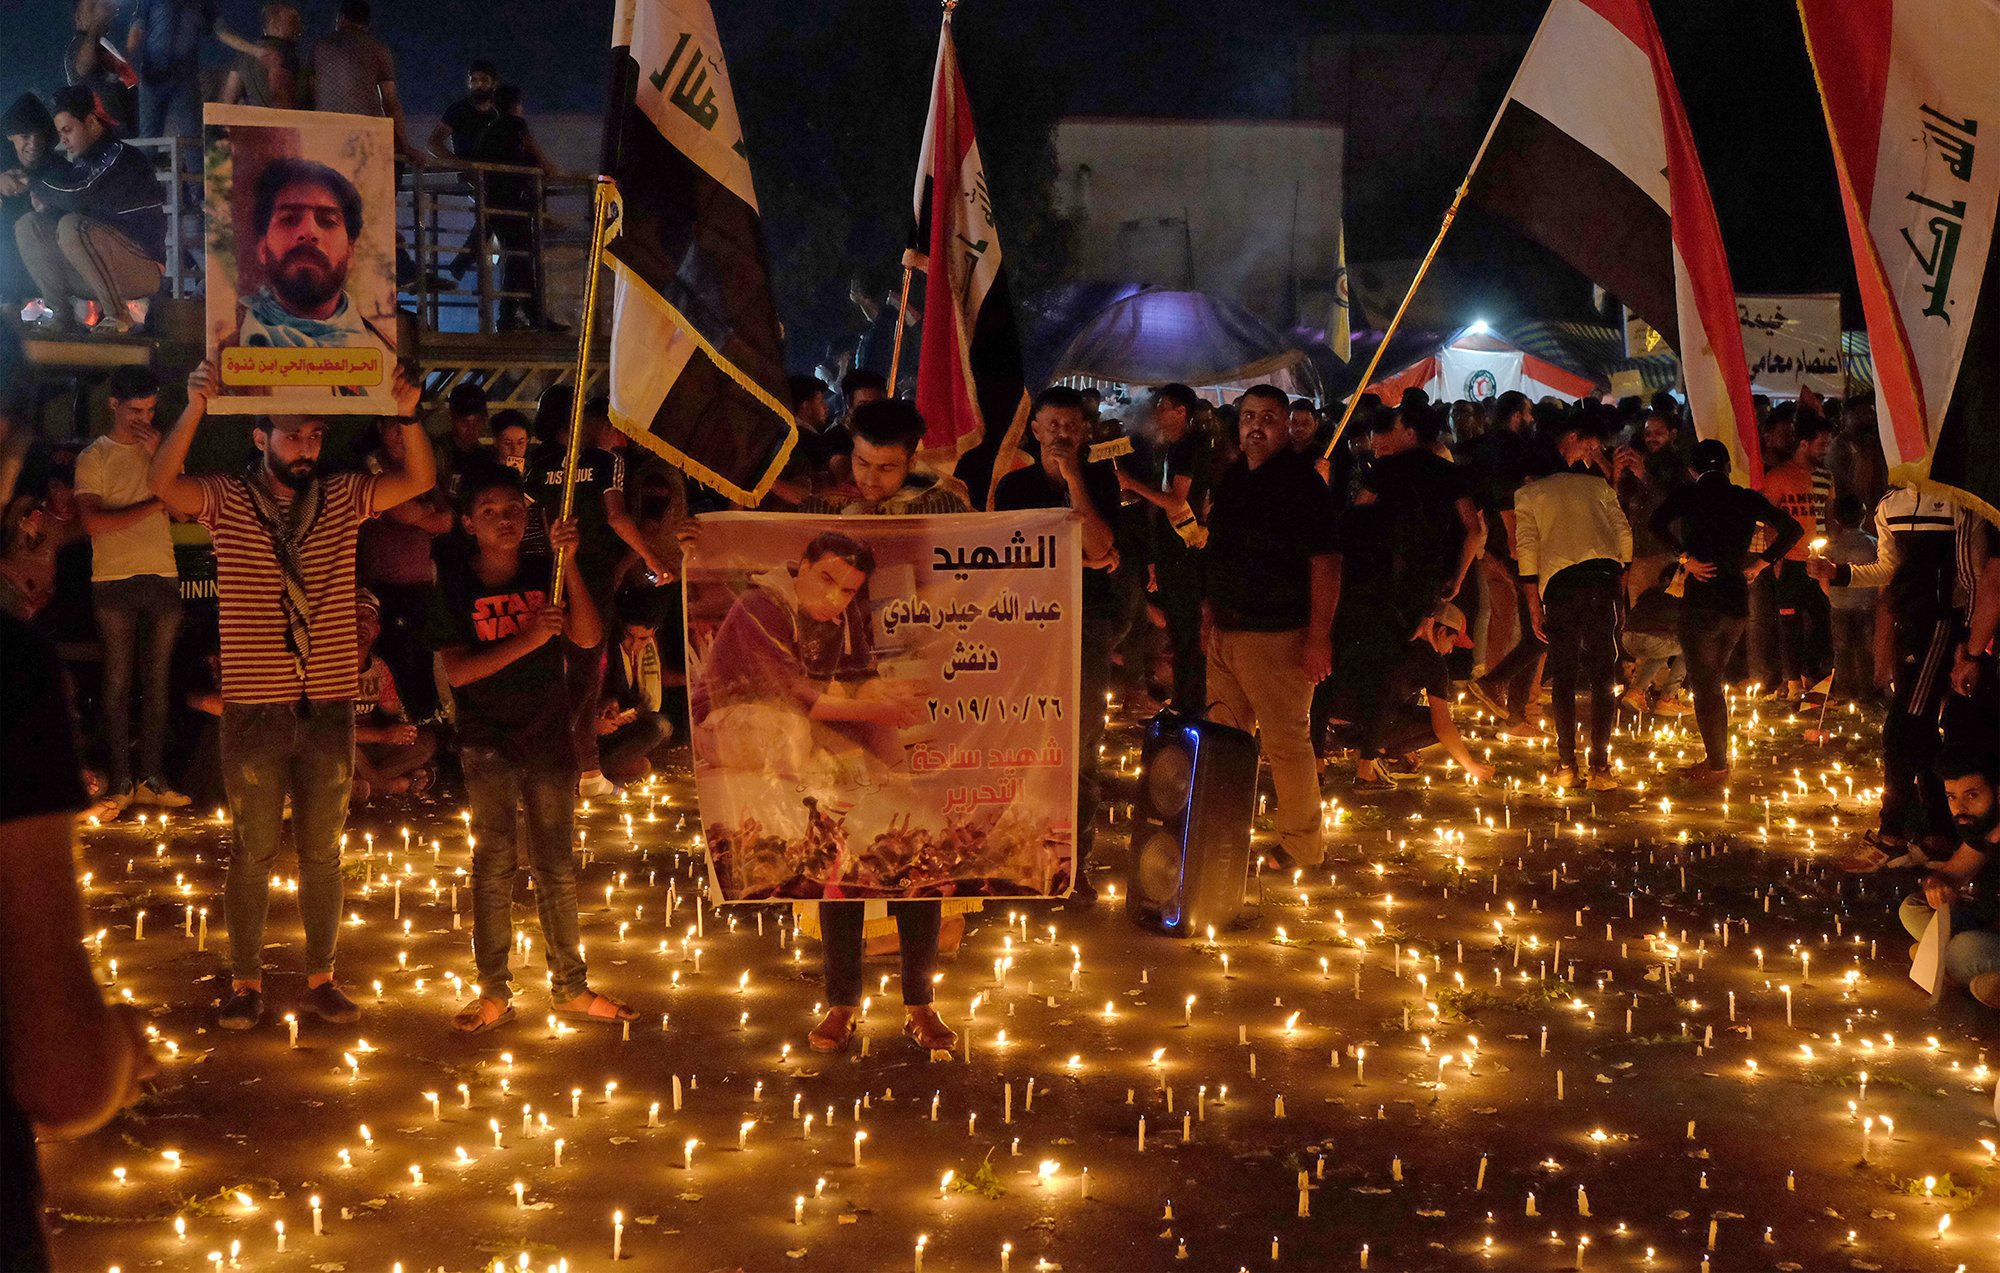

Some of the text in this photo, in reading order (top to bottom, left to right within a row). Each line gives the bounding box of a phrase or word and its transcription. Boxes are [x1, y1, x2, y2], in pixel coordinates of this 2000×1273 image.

[1911, 103, 1978, 182] الله
[259, 359, 278, 373] ابن
[280, 358, 306, 377] الحي
[307, 358, 348, 374] العظيم
[932, 530, 1056, 581] الشهيد
[883, 595, 931, 634] هادي
[932, 597, 983, 631] حيدر
[1024, 593, 1062, 629] عبد
[943, 641, 999, 680] دنفش
[911, 736, 1064, 775] شهيد ساحة
[941, 777, 1026, 815] التحرير
